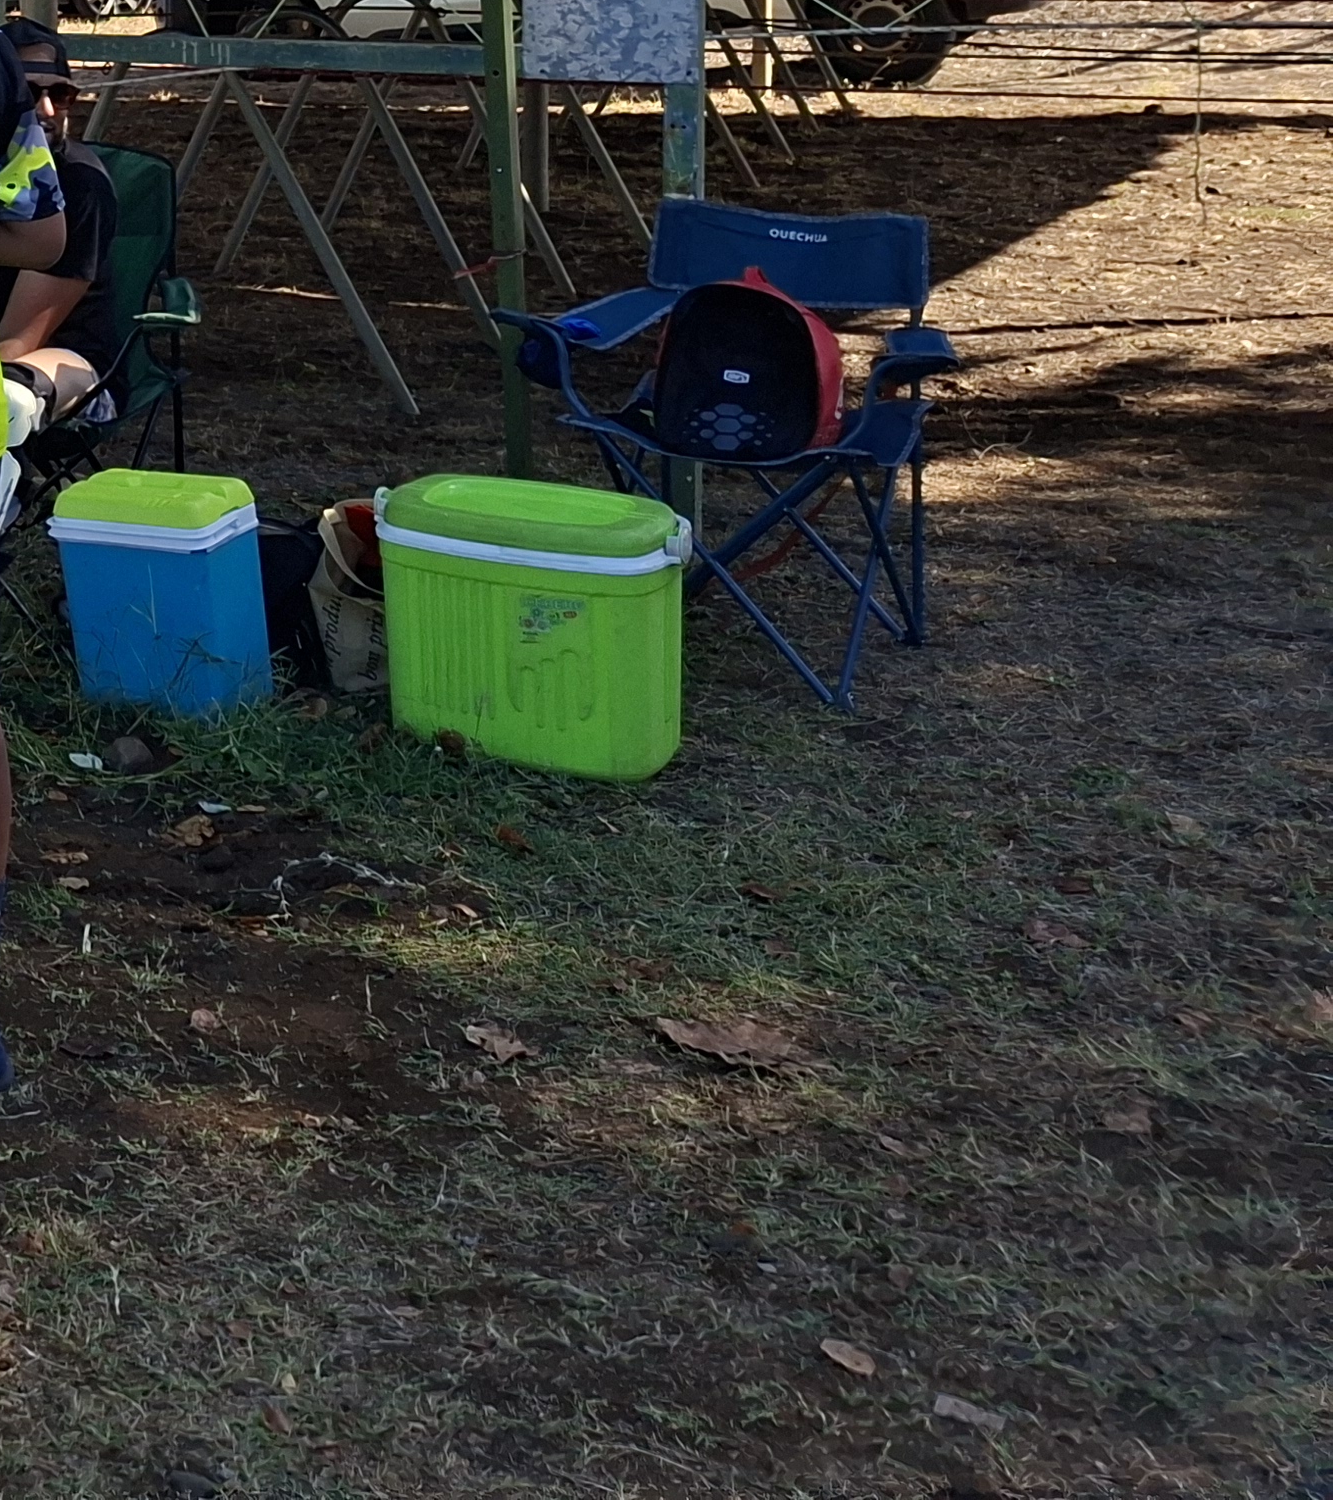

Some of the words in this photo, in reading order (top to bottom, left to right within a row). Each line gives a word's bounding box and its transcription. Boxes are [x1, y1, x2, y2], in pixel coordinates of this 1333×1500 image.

[768, 227, 828, 243] QUECHUA
[321, 596, 343, 658] produ
[356, 650, 381, 681] bon
